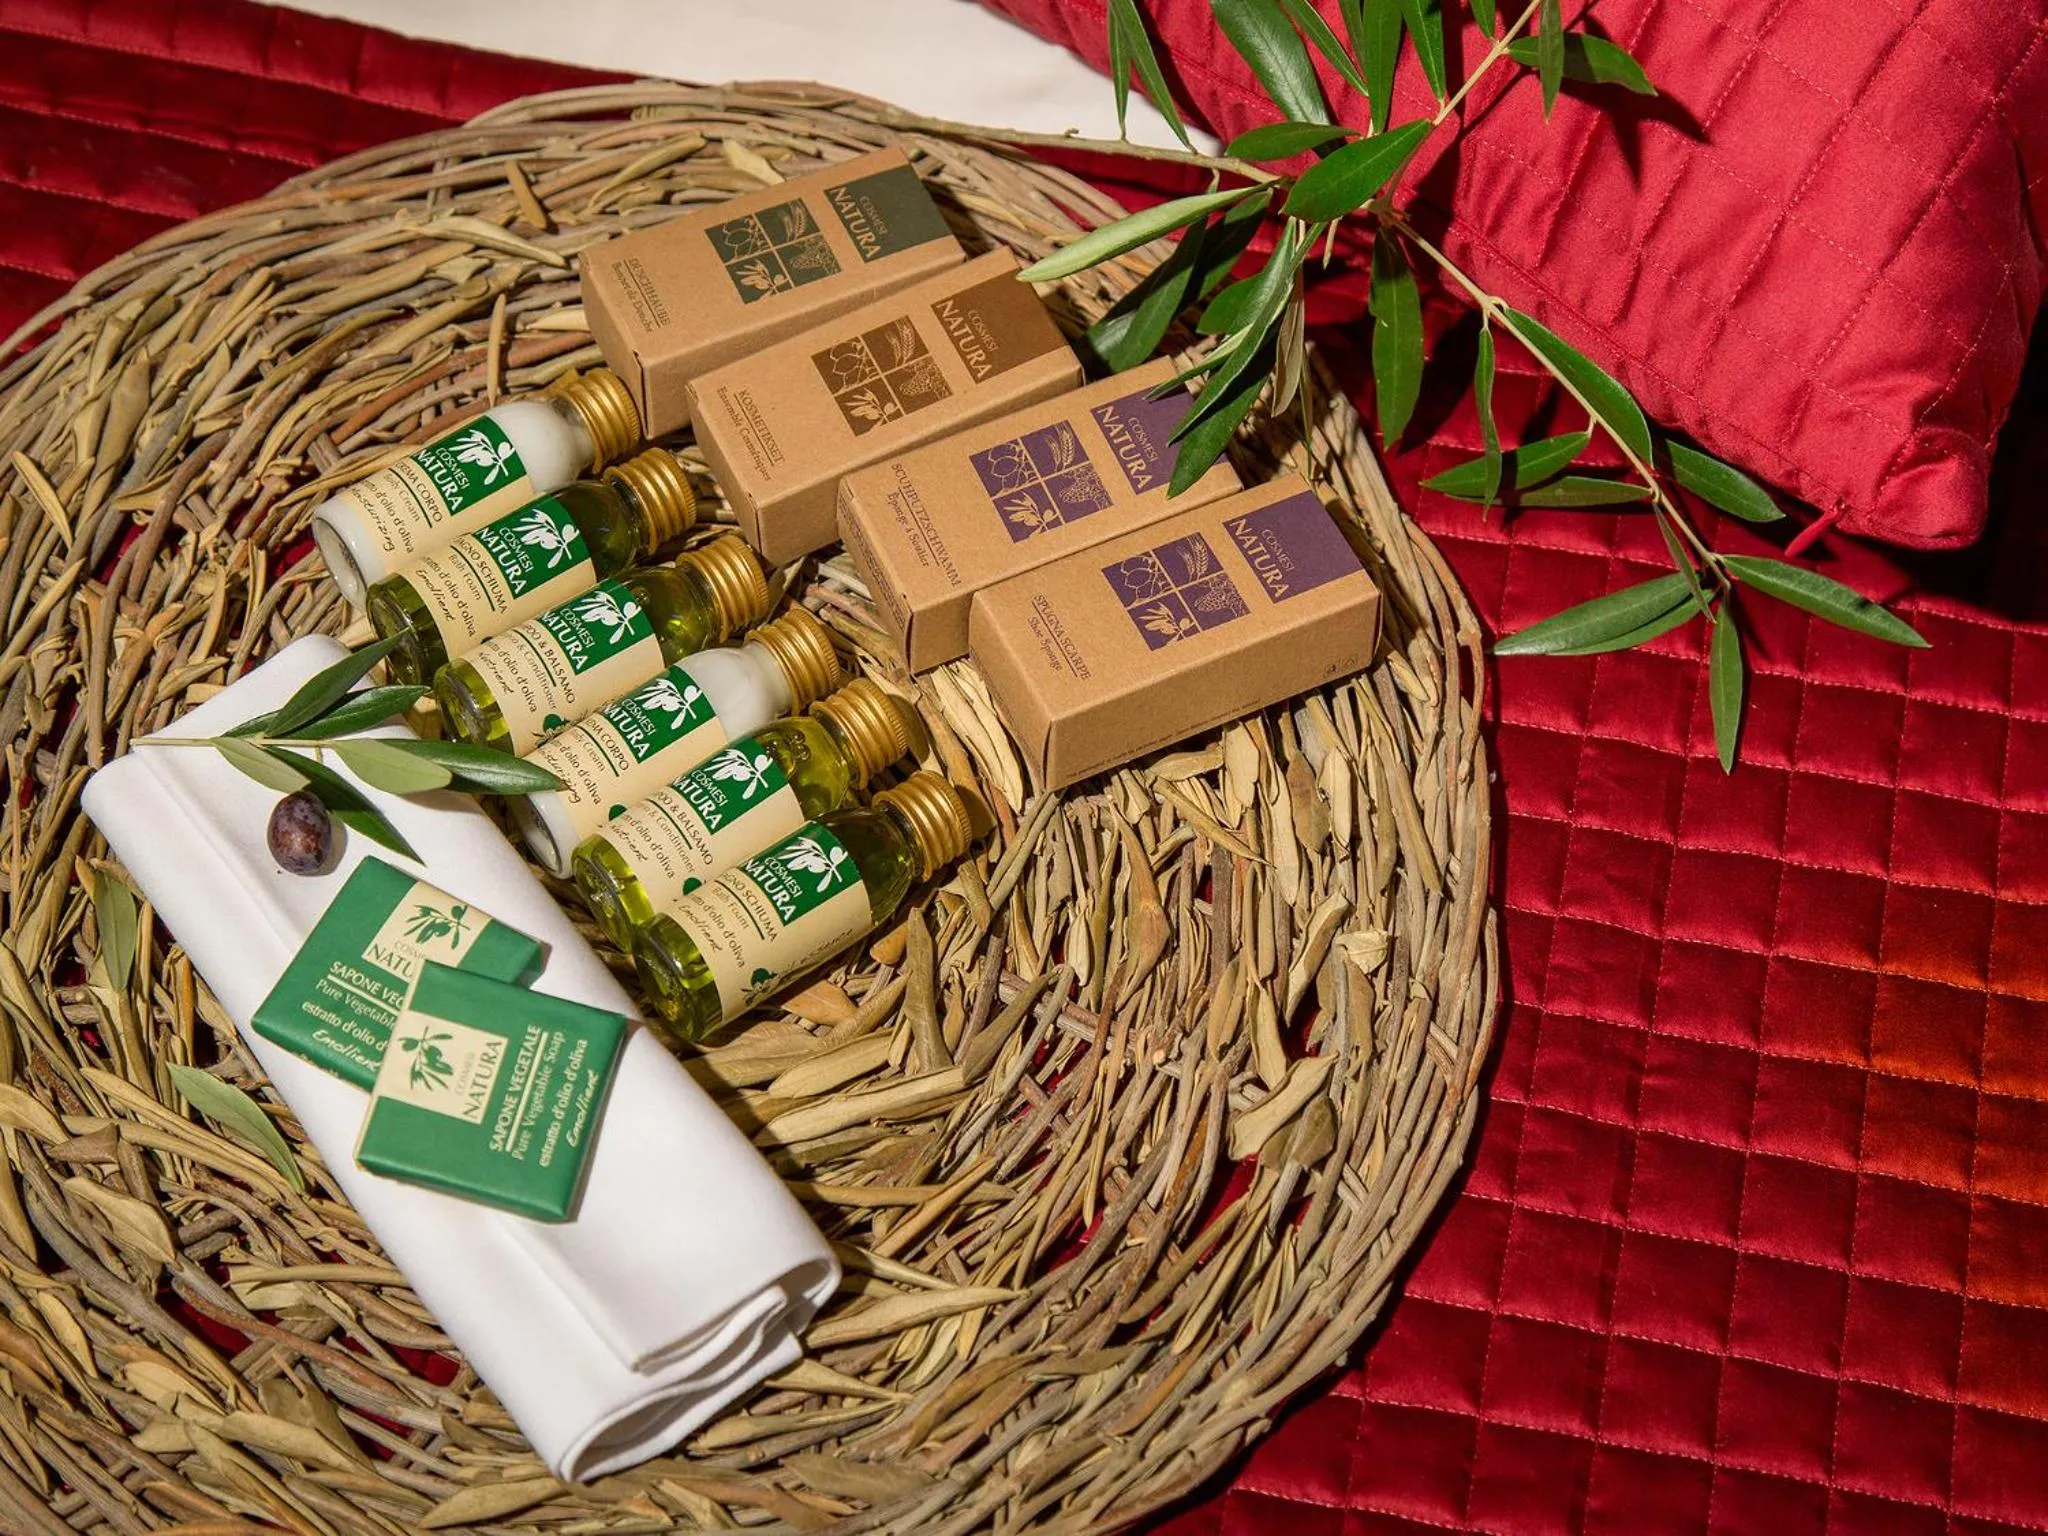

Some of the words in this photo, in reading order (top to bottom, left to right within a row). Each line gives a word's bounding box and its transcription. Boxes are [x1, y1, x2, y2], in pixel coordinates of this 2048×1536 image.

[829, 186, 882, 258] NATURA
[936, 299, 993, 378] NATURA
[968, 309, 999, 352] COSMESI
[716, 385, 743, 428] Ensemble
[738, 389, 785, 463] KOSMETIKSET
[1097, 406, 1153, 489] NATURA
[1128, 417, 1159, 461] COSMESI
[416, 448, 465, 512] NATURA
[436, 447, 471, 490] COSMESI
[398, 490, 421, 522] Cream
[416, 482, 443, 523] CORPO
[475, 527, 527, 595] NATURA
[499, 526, 535, 573] COSMESI
[908, 533, 930, 568] Soulier
[1229, 519, 1290, 598] NATURA
[1262, 529, 1295, 571] COSMESI
[415, 568, 456, 622] Emollient
[448, 553, 465, 573] Bath
[463, 572, 482, 601] Foam
[476, 560, 508, 614] SCHIUMA
[438, 571, 460, 600] d'olio
[457, 600, 477, 637] d'oliva
[560, 607, 596, 649] COSMESI
[541, 610, 589, 670] NATURA
[1027, 616, 1044, 638] Shoe
[1040, 638, 1063, 672] Sponge
[1032, 594, 1065, 638] SPUGNA
[1060, 636, 1092, 681] SCARPE
[497, 649, 519, 677] d'olio
[516, 675, 538, 713] d'oliva
[523, 650, 557, 710] Conditioner
[543, 649, 576, 705] BALSAMO
[621, 698, 657, 737] COSMESI
[582, 741, 606, 772] Cream
[600, 733, 629, 771] CORPO
[577, 769, 601, 806] d'oliva
[690, 769, 729, 808] COSMESI
[649, 842, 676, 880] d'oliva
[655, 816, 696, 873] Conditioner
[676, 811, 714, 865] BALSAMO
[744, 858, 797, 922] NATURA
[764, 857, 803, 898] COSMESI
[678, 904, 723, 953] Emollient
[702, 904, 726, 930] d'olio
[722, 930, 745, 969] d'oliva
[742, 889, 778, 942] SCHIUMA
[329, 960, 382, 996] SAPONE
[366, 943, 414, 979] NATU
[315, 978, 344, 1001] Pure
[301, 1001, 342, 1028] estratto
[342, 1020, 376, 1046] d'olio
[543, 1031, 566, 1066] Soap
[312, 1029, 383, 1073] Emollient
[462, 1039, 503, 1119] NATURA
[488, 1093, 519, 1153] SAPONE
[507, 1023, 543, 1093] VEGETALE
[521, 1067, 554, 1128] Vegetable
[538, 1121, 562, 1168] estratto
[551, 1081, 575, 1121] d'olio
[563, 1038, 589, 1082] d'oliva
[566, 1068, 600, 1148] Emollient
[511, 1129, 532, 1161] Pure
